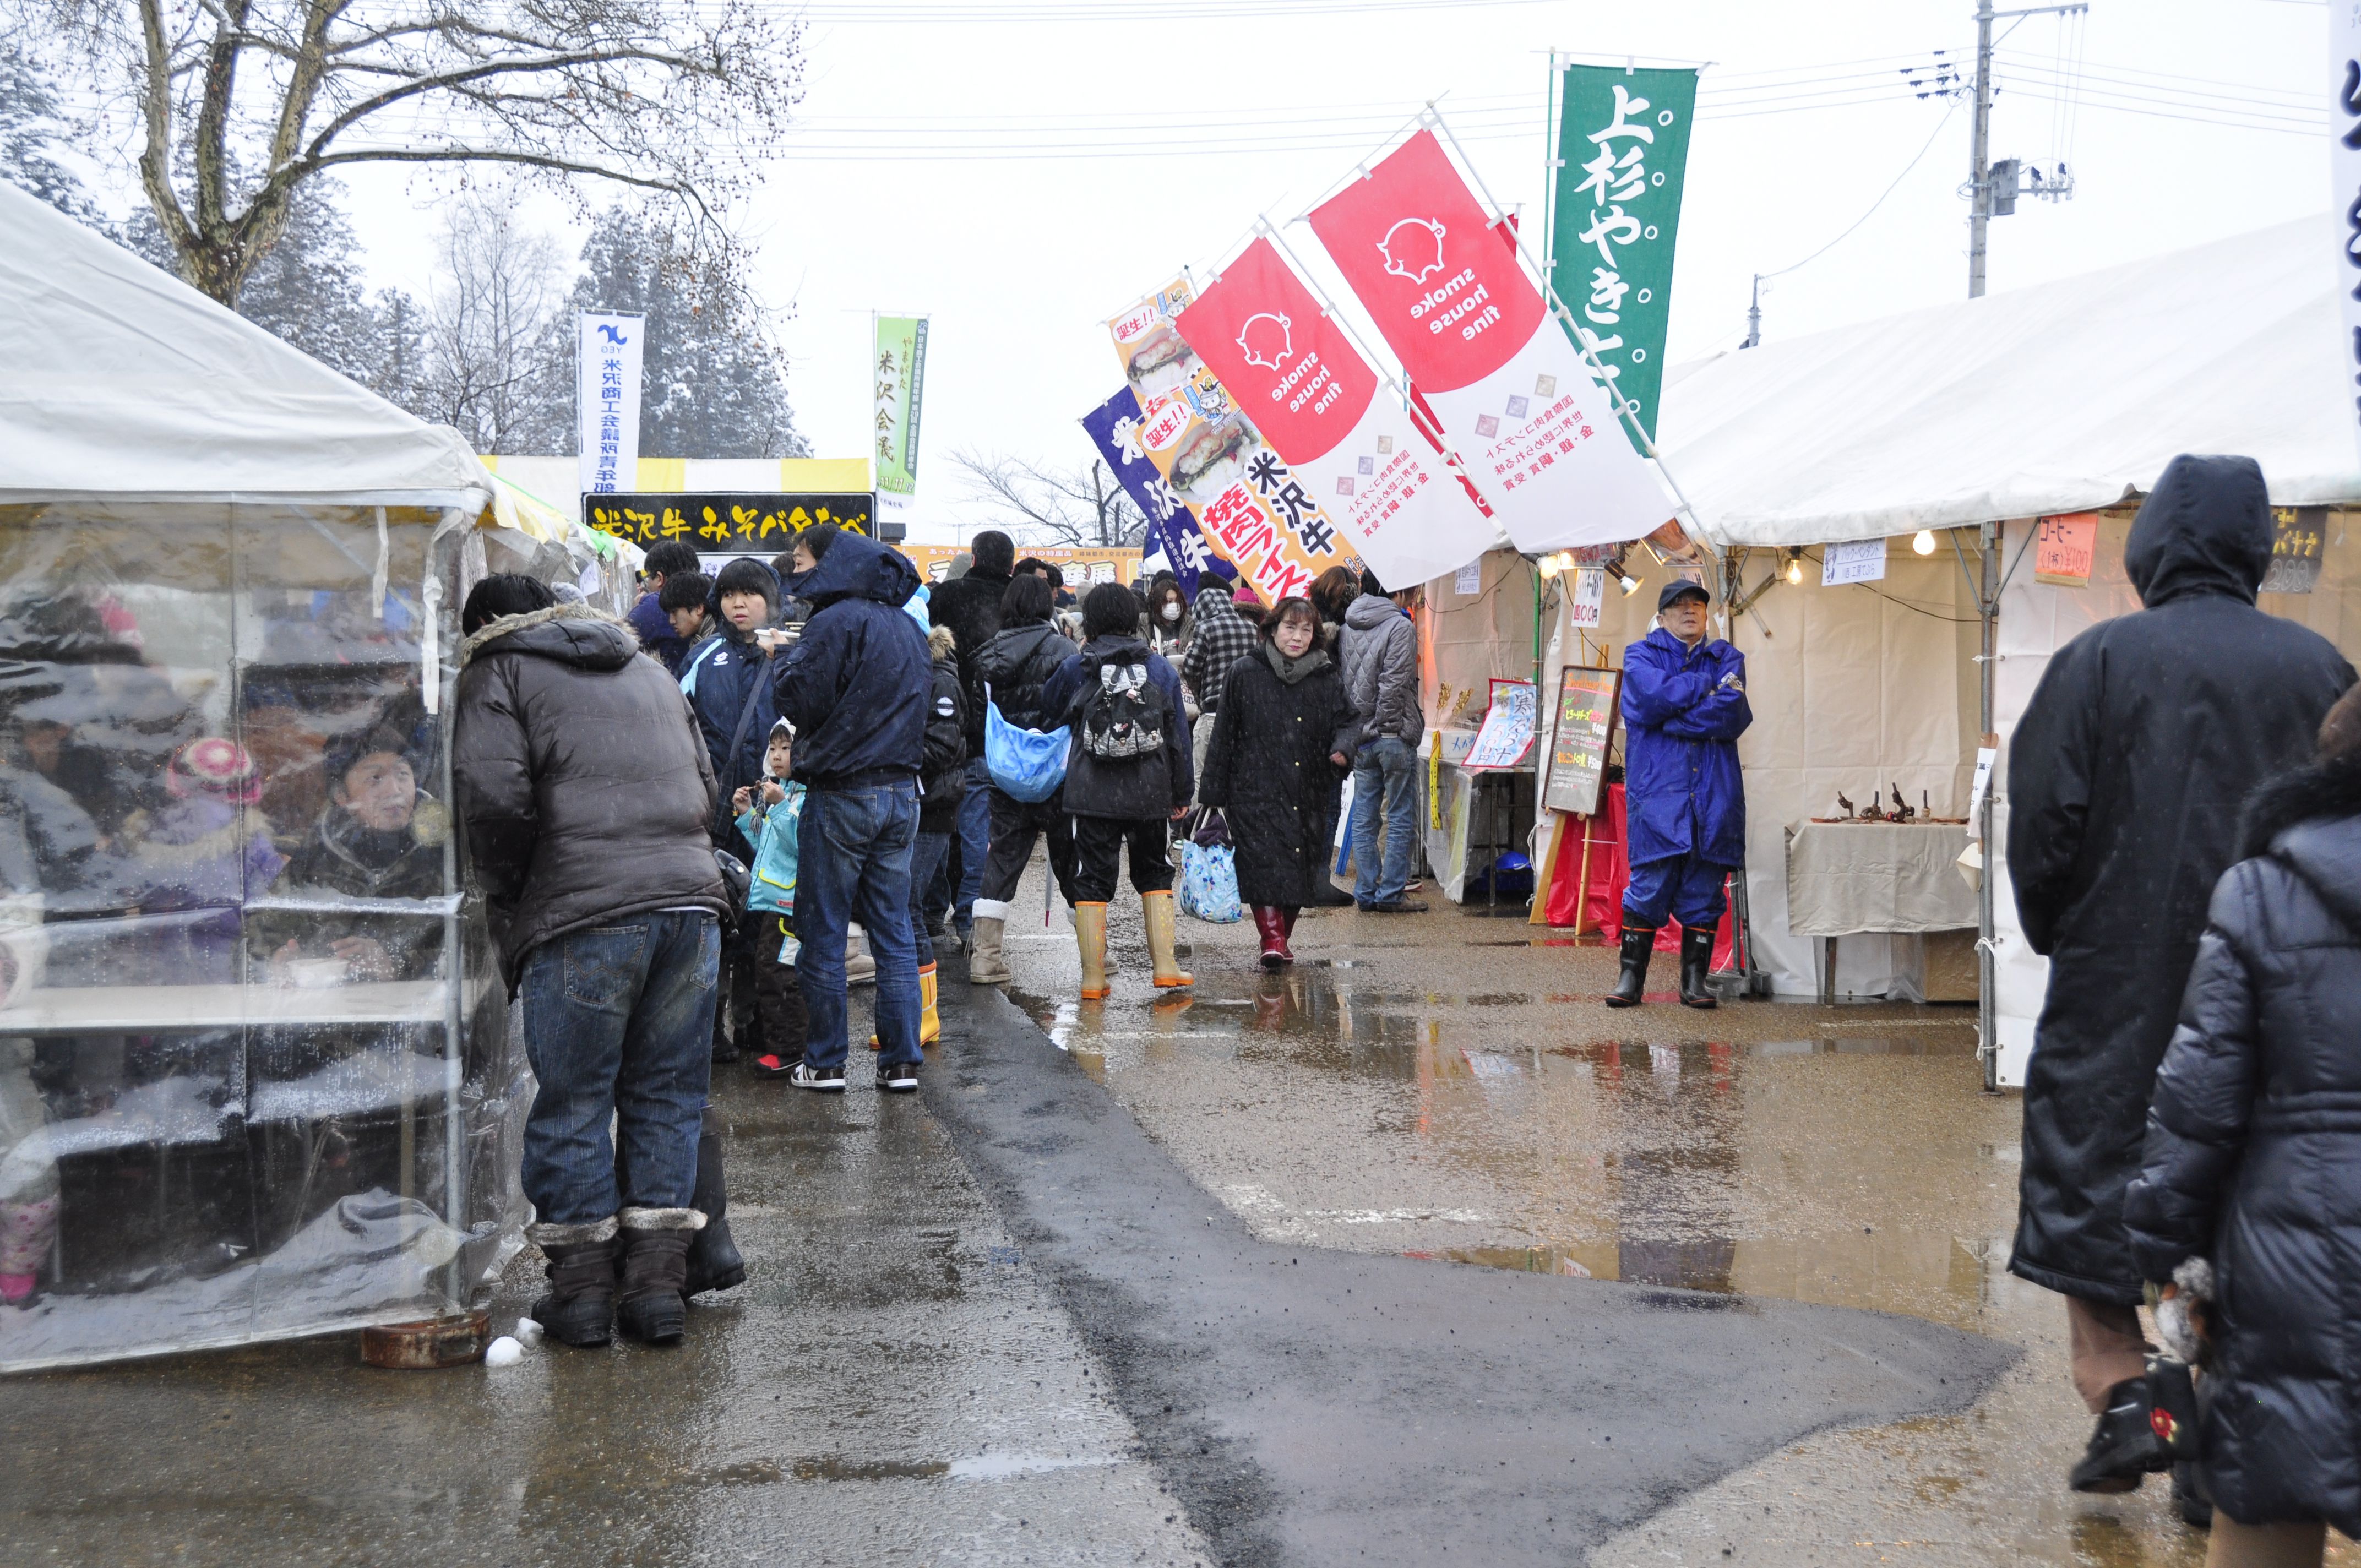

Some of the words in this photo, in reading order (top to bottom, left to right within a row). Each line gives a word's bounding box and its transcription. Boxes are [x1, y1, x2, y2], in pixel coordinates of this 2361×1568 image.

[1574, 85, 1654, 407] 上杉やきと
[899, 336, 912, 390] やまがた
[1248, 450, 1335, 554] 米沢牛
[2040, 519, 2072, 544] コーヒー
[1018, 548, 1073, 557] 米沢の特産品
[1203, 482, 1315, 602] 焼肉ライス
[1493, 688, 1535, 765] 寒だら汁
